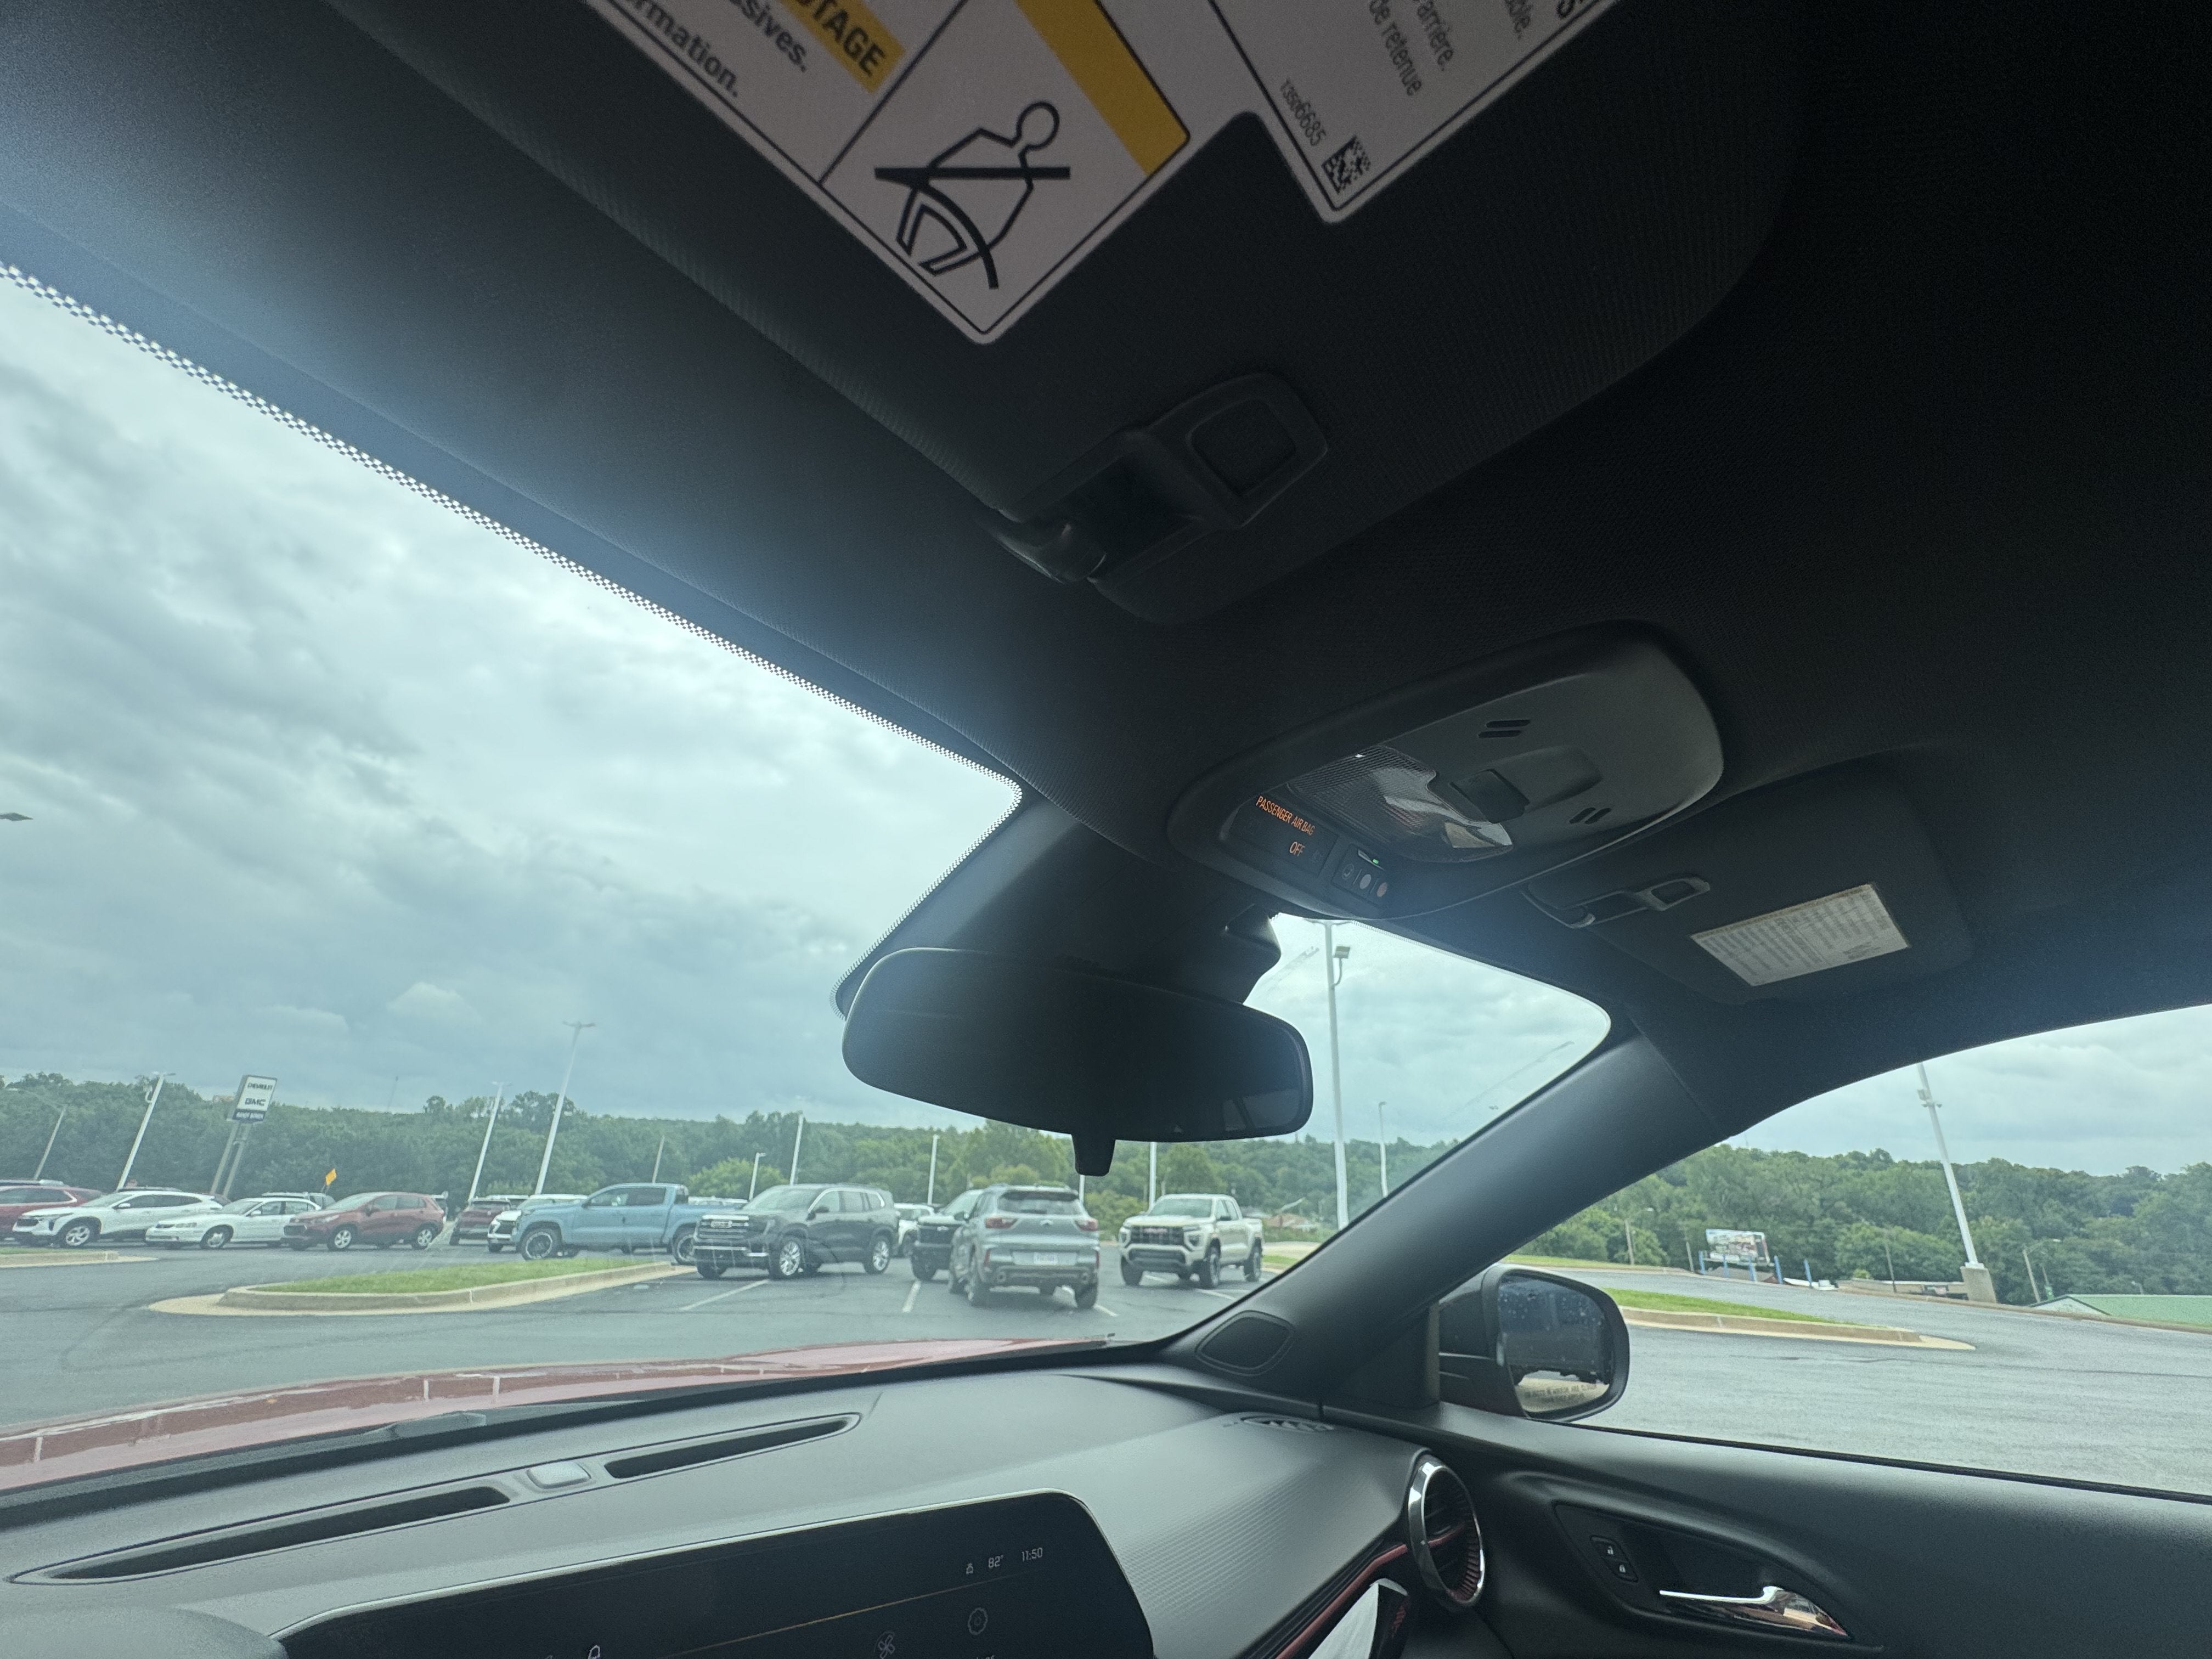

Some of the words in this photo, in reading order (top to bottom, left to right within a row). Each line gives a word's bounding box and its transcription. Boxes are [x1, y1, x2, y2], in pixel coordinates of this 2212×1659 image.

[730, 0, 806, 72] sives.
[797, 0, 885, 77] TAGE
[1381, 21, 1423, 96] retenue
[1255, 795, 1293, 823] PASSENGER
[1289, 841, 1306, 857] OFF
[1022, 1547, 1043, 1562] 11:50
